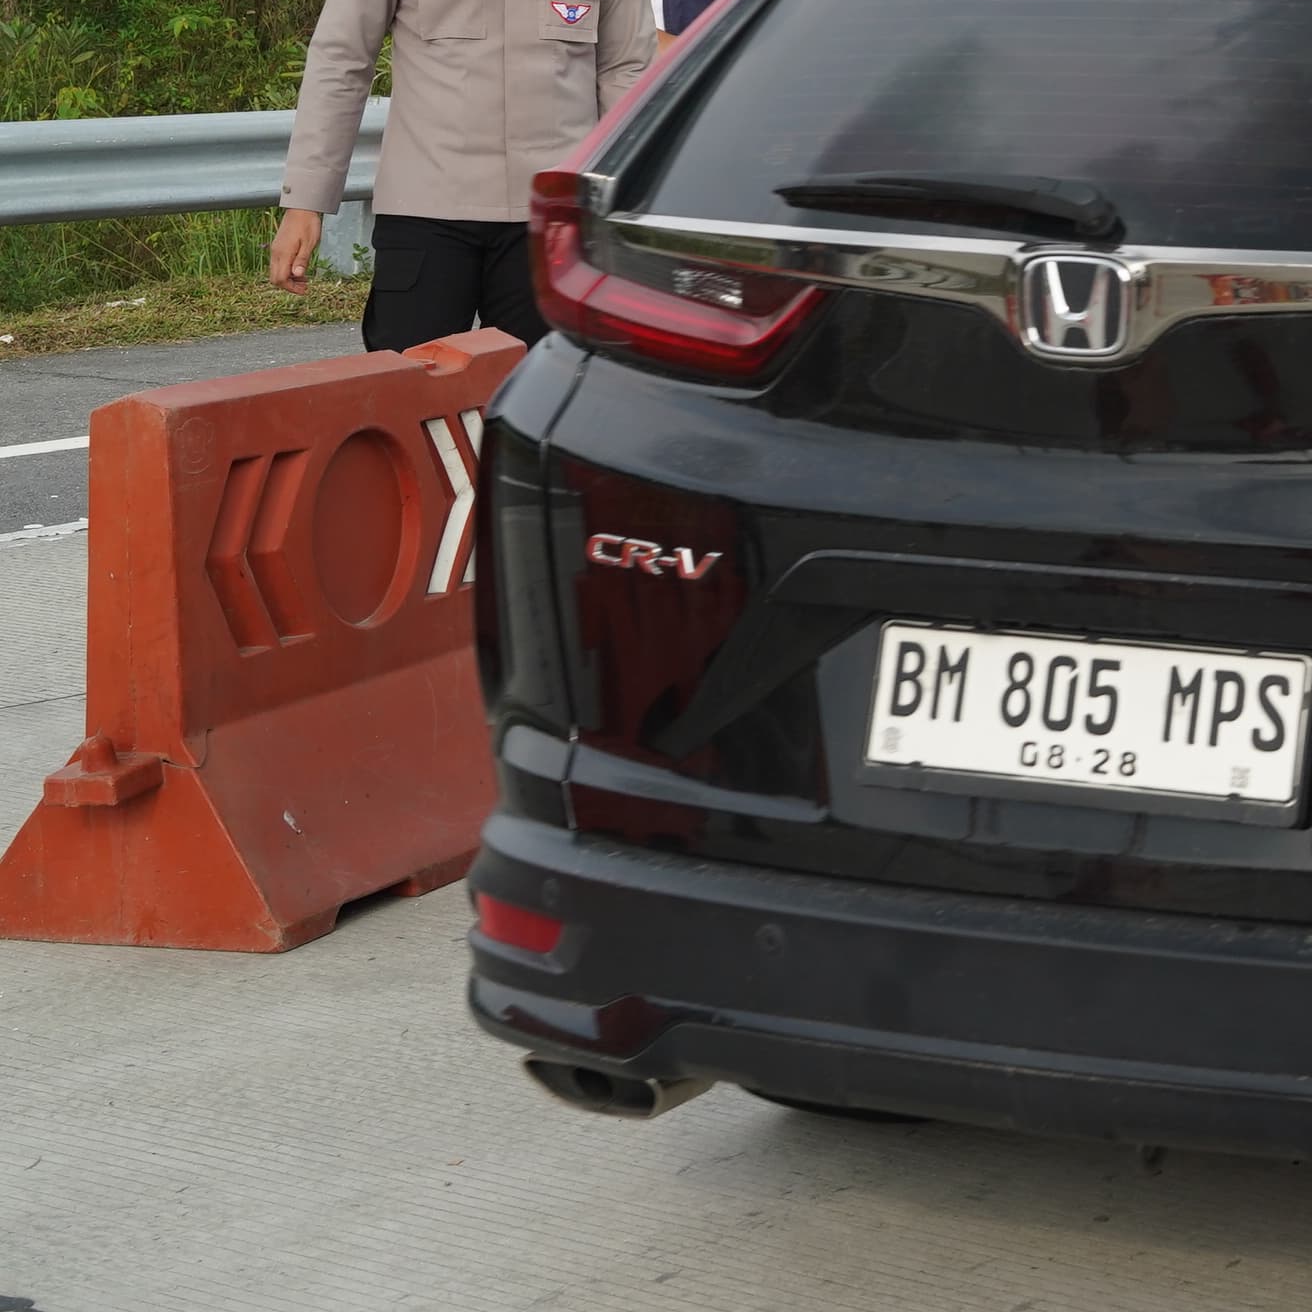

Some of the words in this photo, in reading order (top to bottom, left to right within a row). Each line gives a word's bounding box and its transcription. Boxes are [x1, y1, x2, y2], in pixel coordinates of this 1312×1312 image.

[587, 533, 723, 579] CR-V
[890, 641, 970, 722] BM
[1000, 651, 1121, 735] 805
[1162, 664, 1290, 752] MPS
